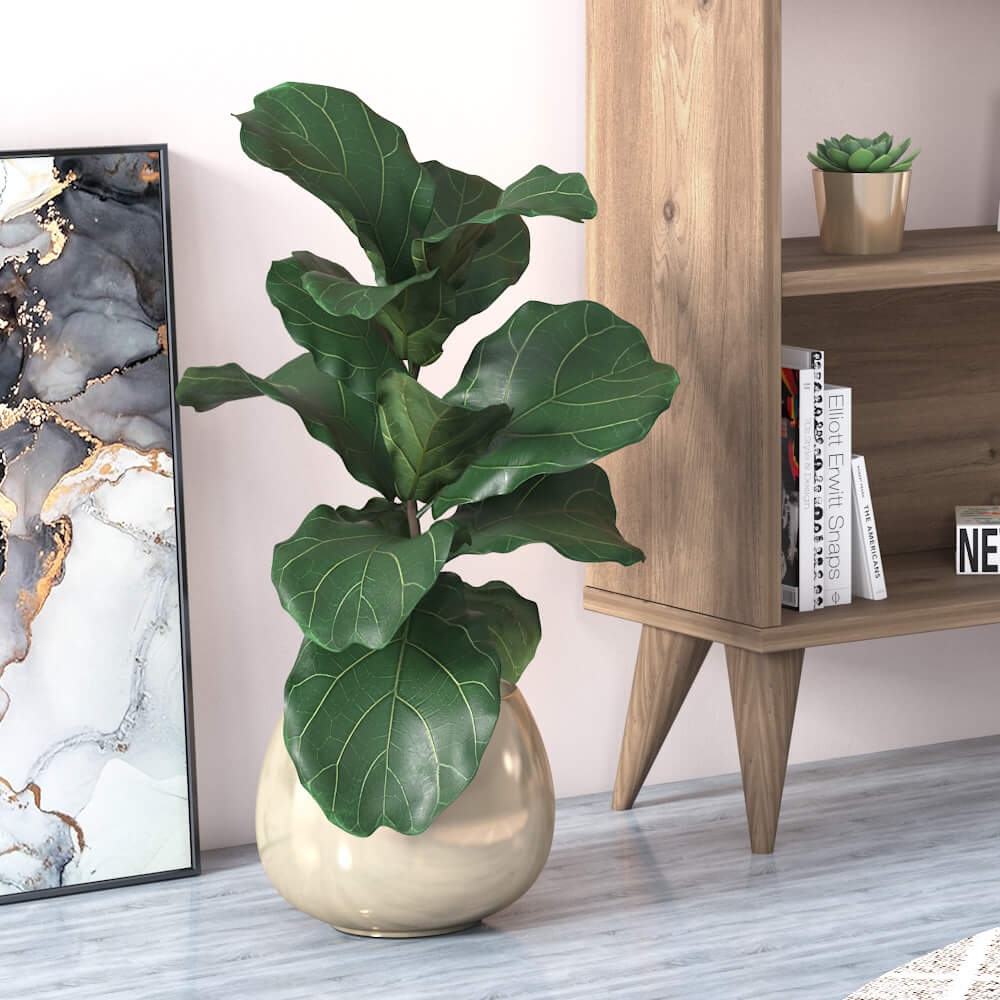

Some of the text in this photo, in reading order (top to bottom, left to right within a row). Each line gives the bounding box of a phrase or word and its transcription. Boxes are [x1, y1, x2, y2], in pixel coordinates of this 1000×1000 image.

[826, 394, 845, 581] Elliott Erwitt Snaps
[863, 504, 881, 580] THE AMERICANS
